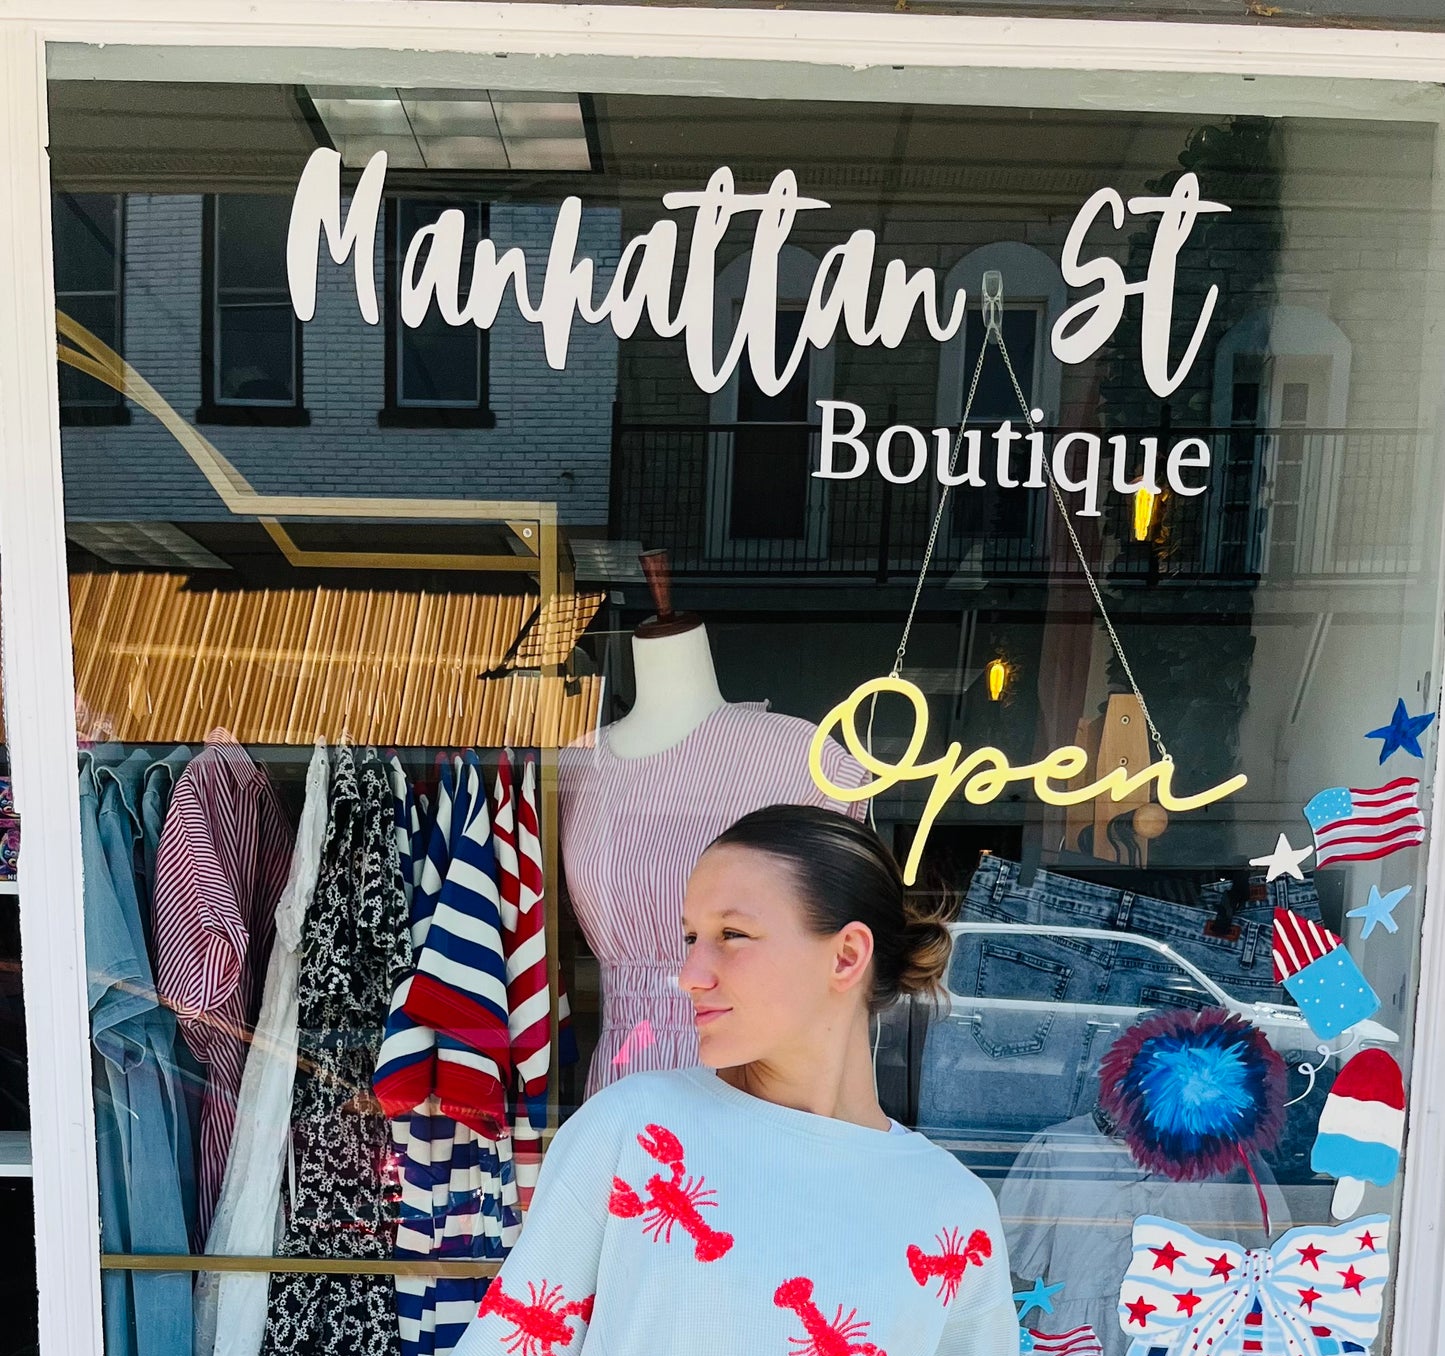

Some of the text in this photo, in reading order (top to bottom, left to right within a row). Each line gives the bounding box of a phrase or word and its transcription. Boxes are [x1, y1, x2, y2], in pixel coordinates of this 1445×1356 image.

[286, 147, 1232, 398] Manhattan St
[811, 400, 1211, 517] Boutique
[808, 676, 1248, 886] Open
